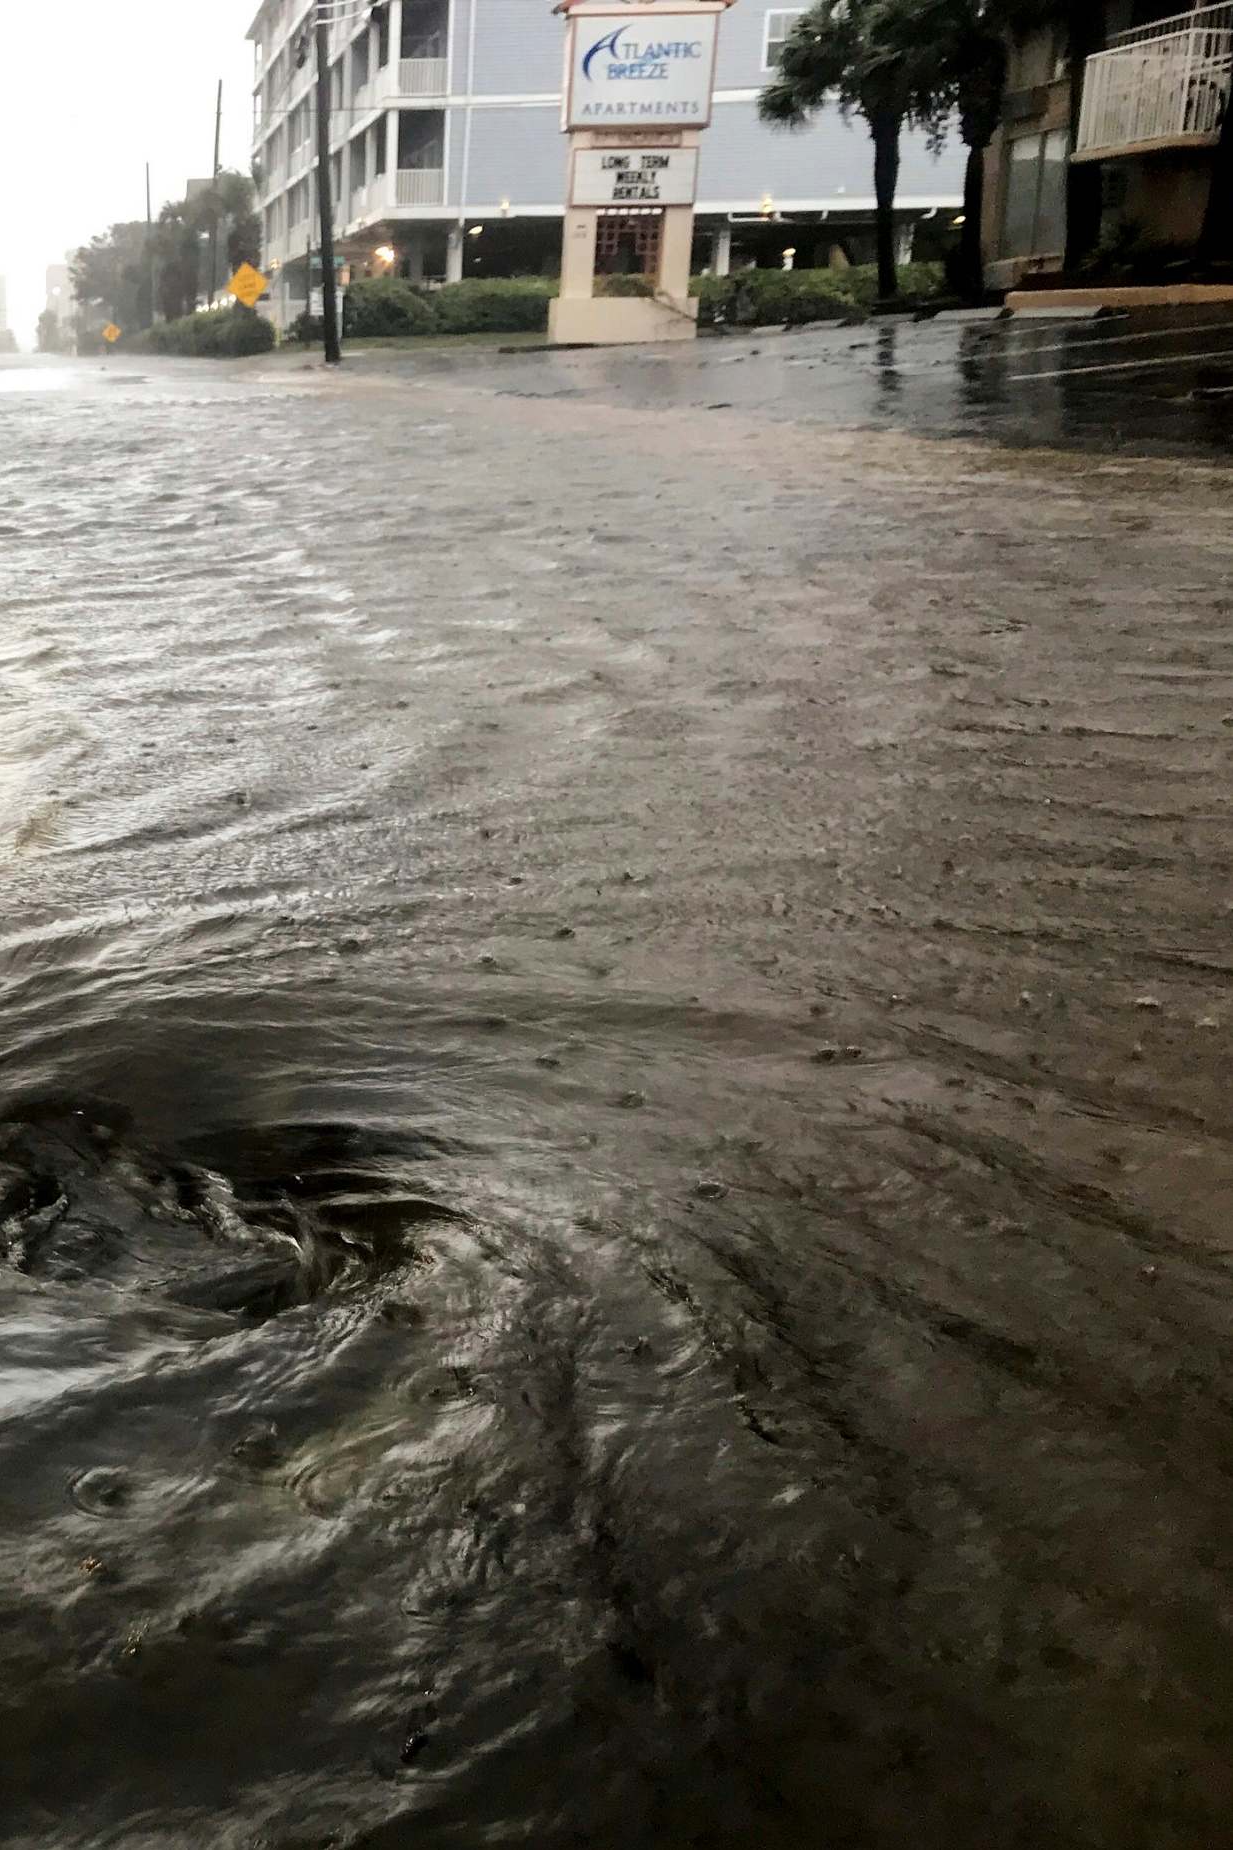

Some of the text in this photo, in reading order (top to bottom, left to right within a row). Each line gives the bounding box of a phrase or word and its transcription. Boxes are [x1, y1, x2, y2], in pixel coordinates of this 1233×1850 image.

[582, 23, 702, 82] ATLANTIC
[606, 62, 670, 80] BREEZE
[582, 101, 699, 115] APARTMENTS
[601, 155, 670, 170] LONG TERM
[616, 171, 656, 184] WEEKLY
[612, 186, 660, 200] RENTALS
